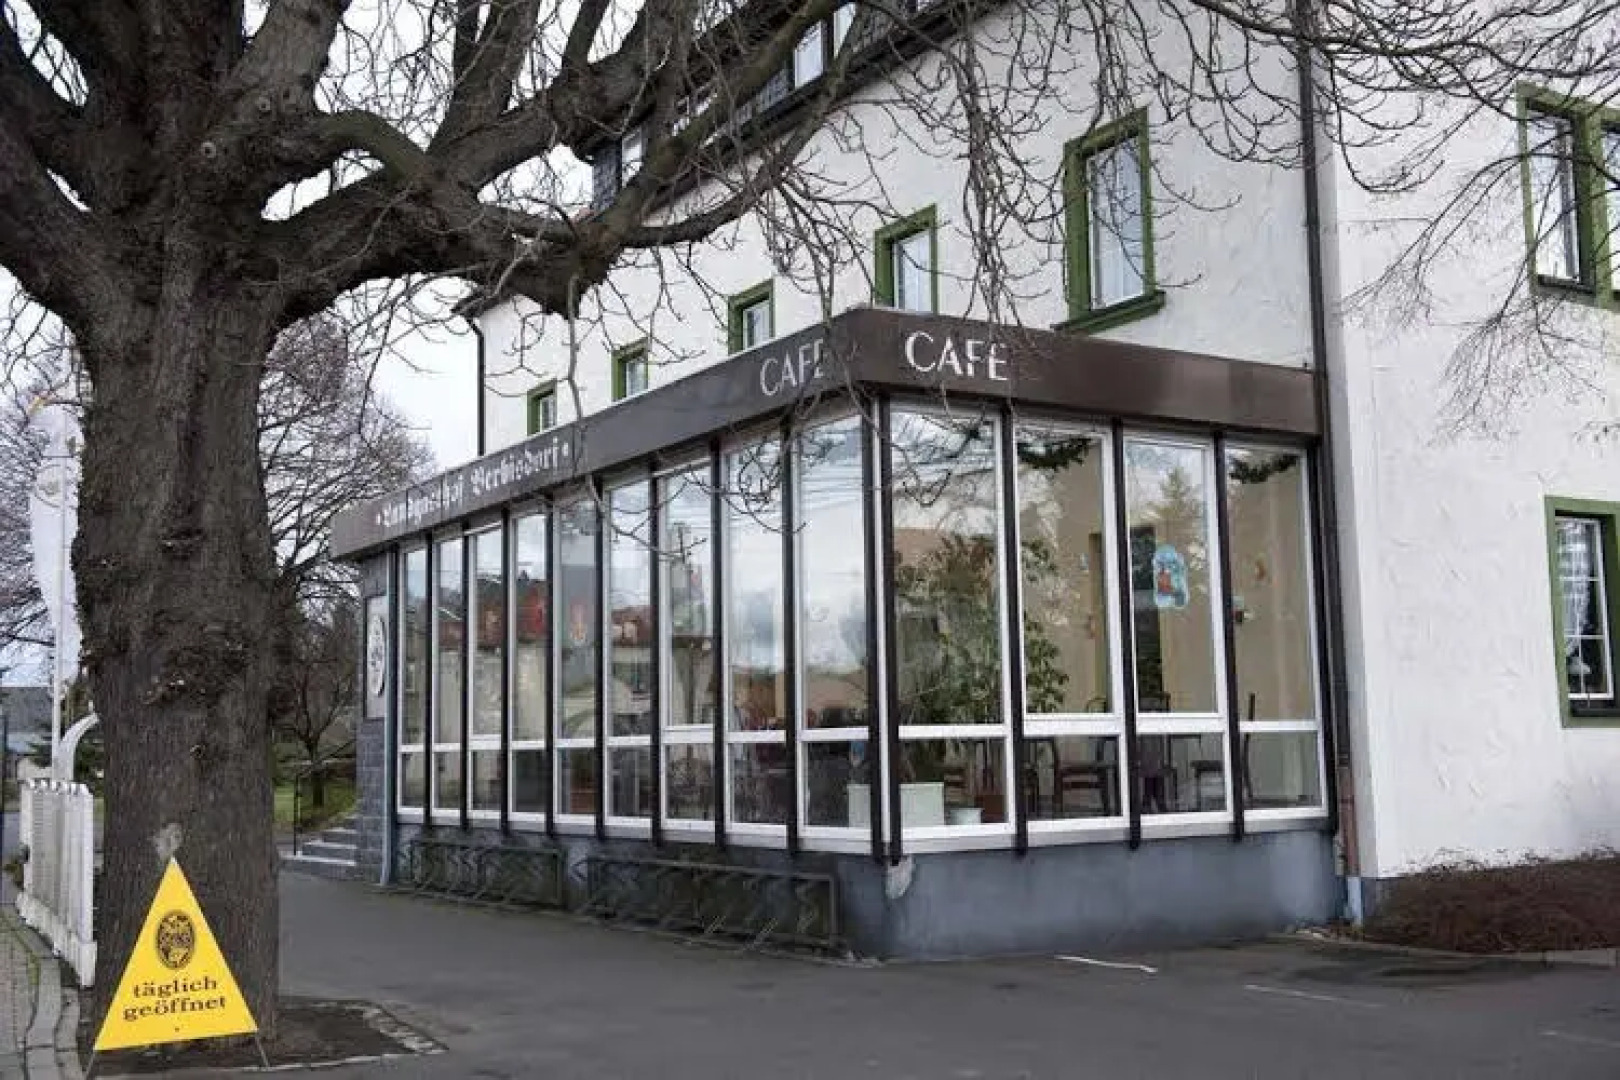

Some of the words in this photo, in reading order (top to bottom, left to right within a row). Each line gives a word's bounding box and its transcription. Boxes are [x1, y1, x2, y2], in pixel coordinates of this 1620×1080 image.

[904, 330, 1008, 381] CAFE
[133, 975, 217, 998] täglich
[123, 996, 226, 1022] geöffnet
